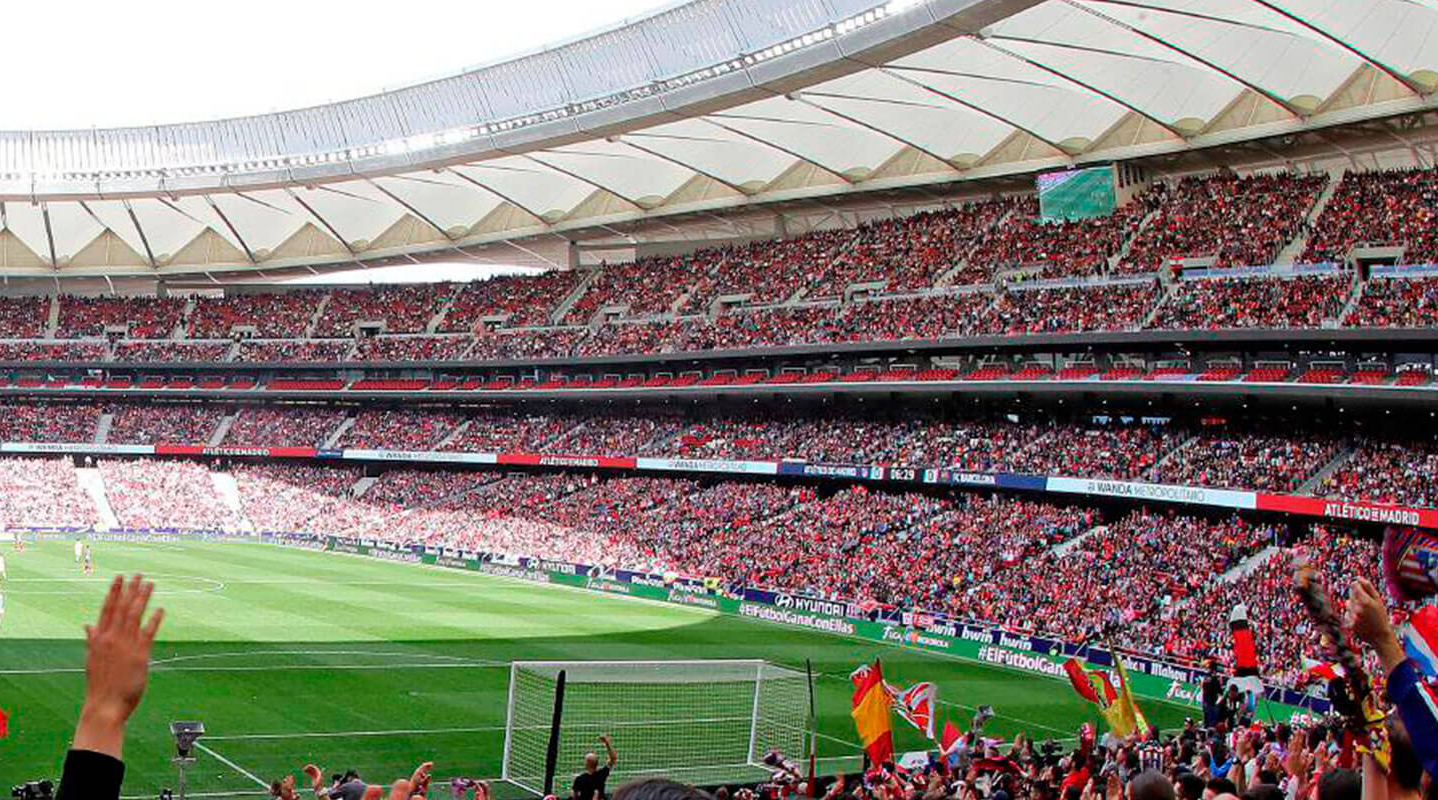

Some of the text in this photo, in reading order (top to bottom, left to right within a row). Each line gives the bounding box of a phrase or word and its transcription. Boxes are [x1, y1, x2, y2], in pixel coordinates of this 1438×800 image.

[1097, 483, 1132, 496] WANDA
[1324, 503, 1370, 521] ATLÉTICO
[1379, 510, 1420, 525] MADRID
[795, 598, 844, 616] HYUNDAI
[962, 626, 994, 644] bwin
